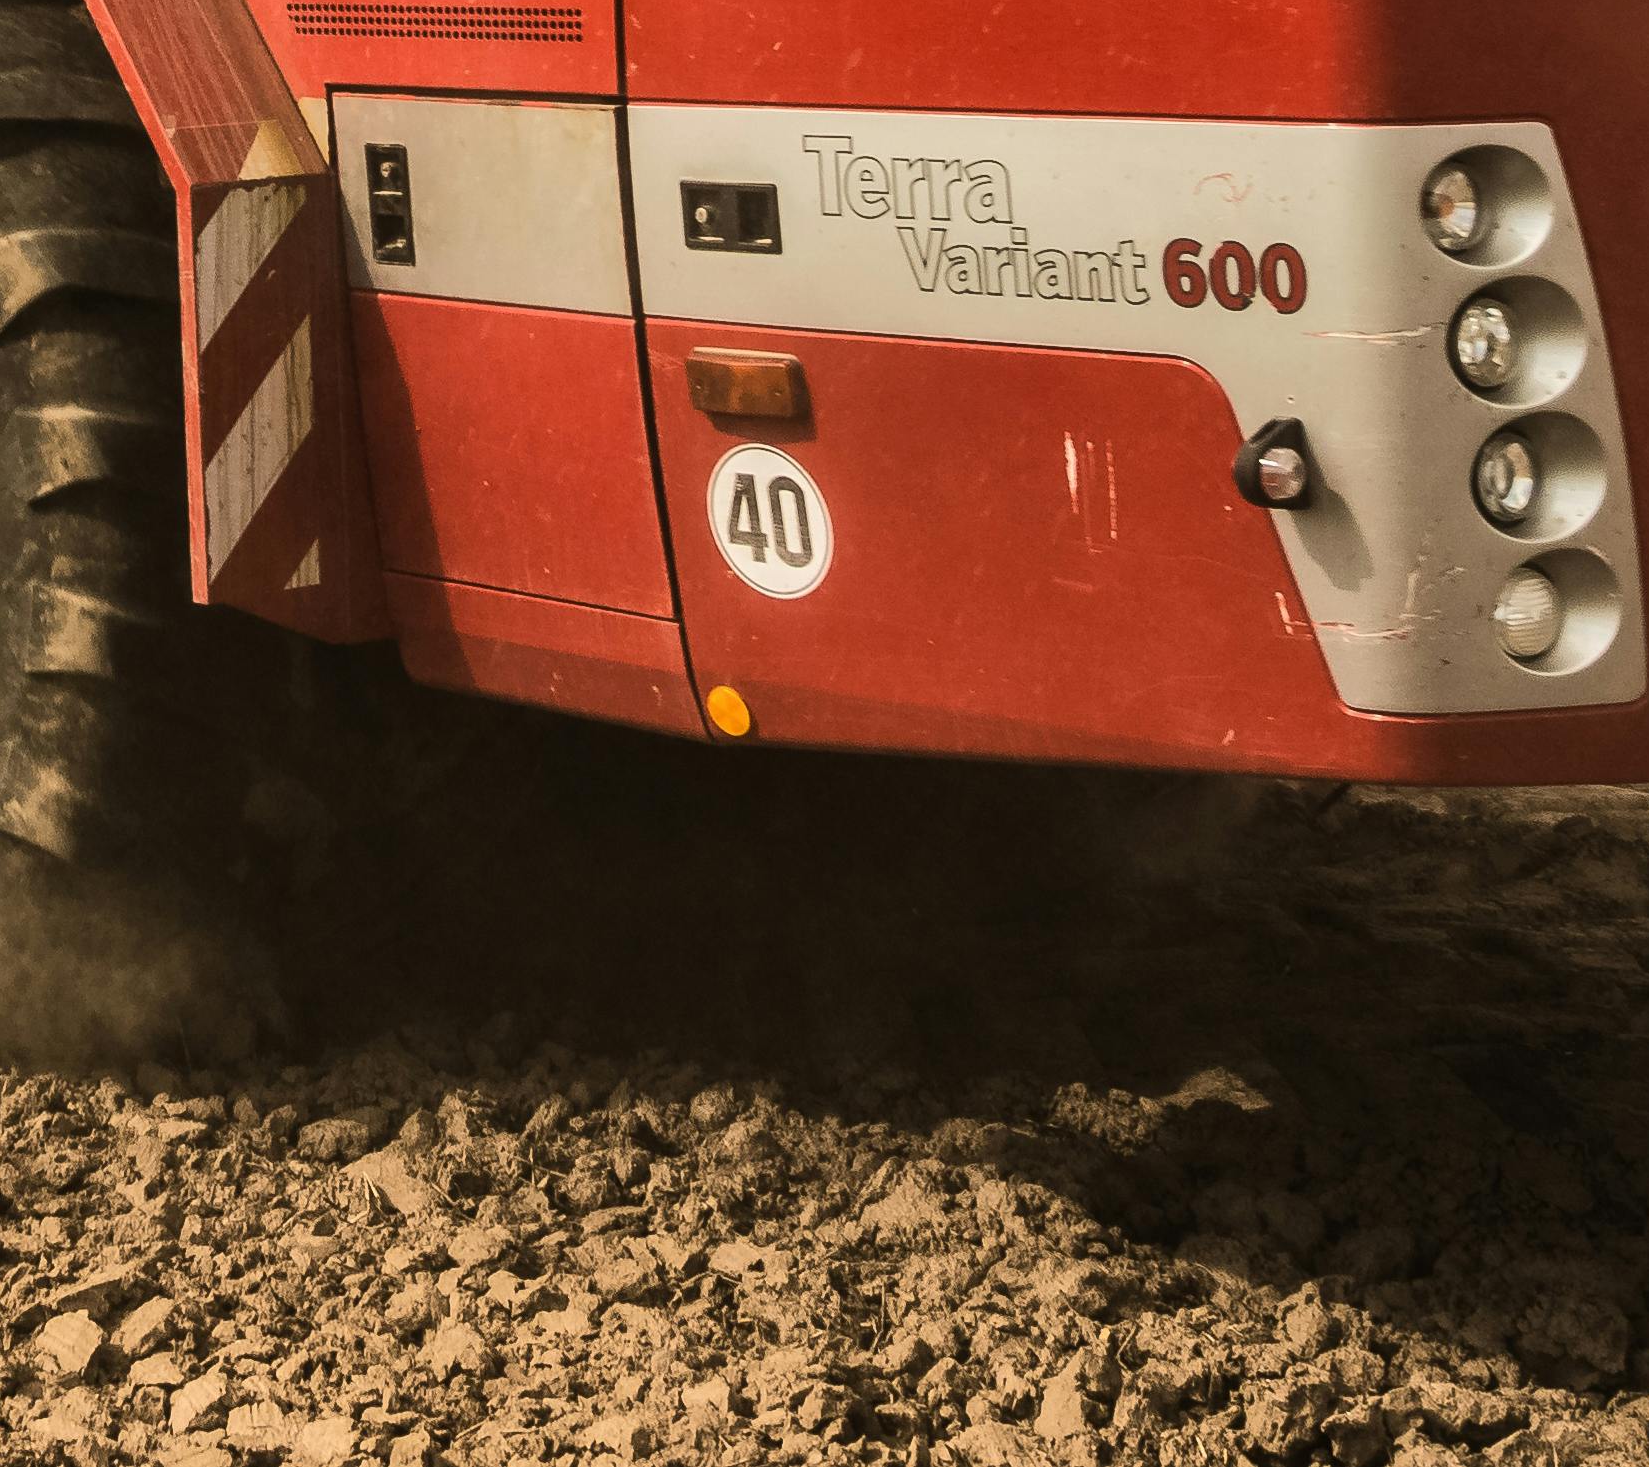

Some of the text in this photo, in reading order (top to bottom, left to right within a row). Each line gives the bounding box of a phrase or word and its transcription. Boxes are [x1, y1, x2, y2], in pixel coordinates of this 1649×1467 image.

[803, 135, 1015, 224] Terra
[895, 226, 1308, 315] Variant 600
[727, 472, 813, 568] 40
